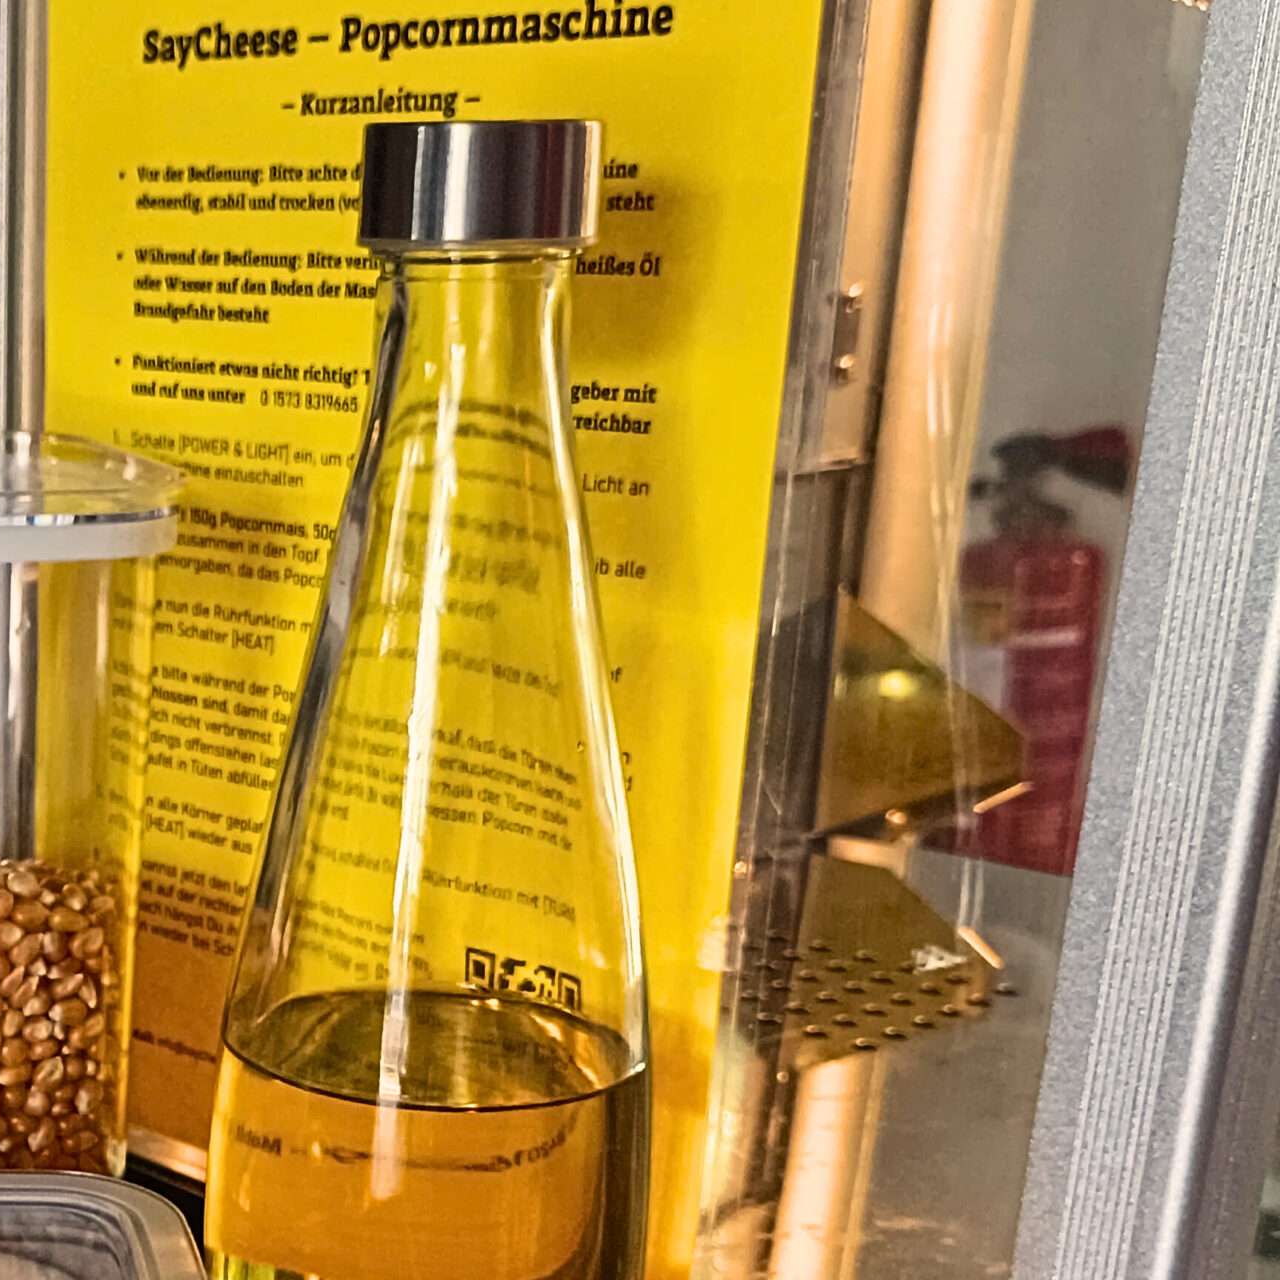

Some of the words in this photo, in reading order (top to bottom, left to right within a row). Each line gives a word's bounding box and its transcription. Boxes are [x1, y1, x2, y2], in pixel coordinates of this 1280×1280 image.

[143, 22, 298, 70] SayCheese
[339, 0, 675, 61] Popcornmaschine
[301, 86, 458, 118] Kurzanleitung
[137, 166, 160, 183] Vor
[163, 166, 184, 183] der
[187, 166, 263, 186] Bedienung:
[268, 165, 304, 182] Bitte
[307, 165, 348, 182] achte
[603, 159, 638, 179] ine
[208, 193, 245, 211] stabil
[248, 194, 276, 211] und
[279, 193, 336, 212] trocken
[135, 247, 196, 266] Während
[200, 249, 221, 267] der
[223, 250, 301, 273] Bedienung:
[307, 251, 342, 270] Bitte
[575, 254, 635, 277] heißes
[639, 250, 661, 277] Öl
[134, 274, 162, 292] oder
[165, 275, 213, 293] Wasser
[216, 276, 239, 295] auf
[241, 277, 267, 296] den
[270, 278, 314, 298] Boden
[317, 280, 341, 298] der
[344, 281, 379, 300] Mas
[134, 301, 215, 323] Brandgefahr
[217, 303, 270, 324] besteht
[132, 353, 216, 375] Funktioniert
[219, 361, 259, 378] etwas
[262, 363, 300, 382] nicht
[570, 381, 620, 405] geber
[623, 384, 658, 405] mit
[132, 380, 156, 397] und
[159, 382, 180, 400] ruf
[181, 387, 206, 402] uns
[208, 388, 246, 405] unter
[573, 411, 652, 435] reichbar
[131, 428, 176, 450] Schalte
[178, 434, 229, 457] [POWER
[233, 441, 243, 458] &
[320, 451, 342, 467] um
[582, 472, 625, 496] Licht
[628, 479, 651, 498] an
[214, 464, 305, 489] einzuschalten
[249, 540, 261, 555] in
[263, 541, 288, 560] den
[158, 552, 235, 576] envorgaben,
[237, 562, 254, 579] da
[257, 564, 281, 583] das
[614, 559, 647, 581] alle
[166, 598, 189, 616] nun
[192, 601, 211, 619] die
[213, 604, 297, 632] Rührfunktion
[177, 621, 230, 645] Schalter
[231, 628, 276, 656] [HEAT]
[162, 664, 189, 682] bitte
[191, 672, 245, 695] während
[248, 681, 270, 698] der
[151, 684, 198, 708] hlossen
[233, 700, 269, 724] damit
[172, 711, 202, 732] nicht
[150, 729, 181, 751] dings
[184, 737, 257, 766] offenstehen
[176, 758, 188, 770] in
[191, 758, 224, 781] Tüten
[157, 797, 179, 815] alle
[180, 801, 224, 825] Körner
[225, 814, 265, 835] geplat
[188, 828, 229, 848] wieder
[231, 839, 254, 856] aus
[180, 867, 207, 886] jetzt
